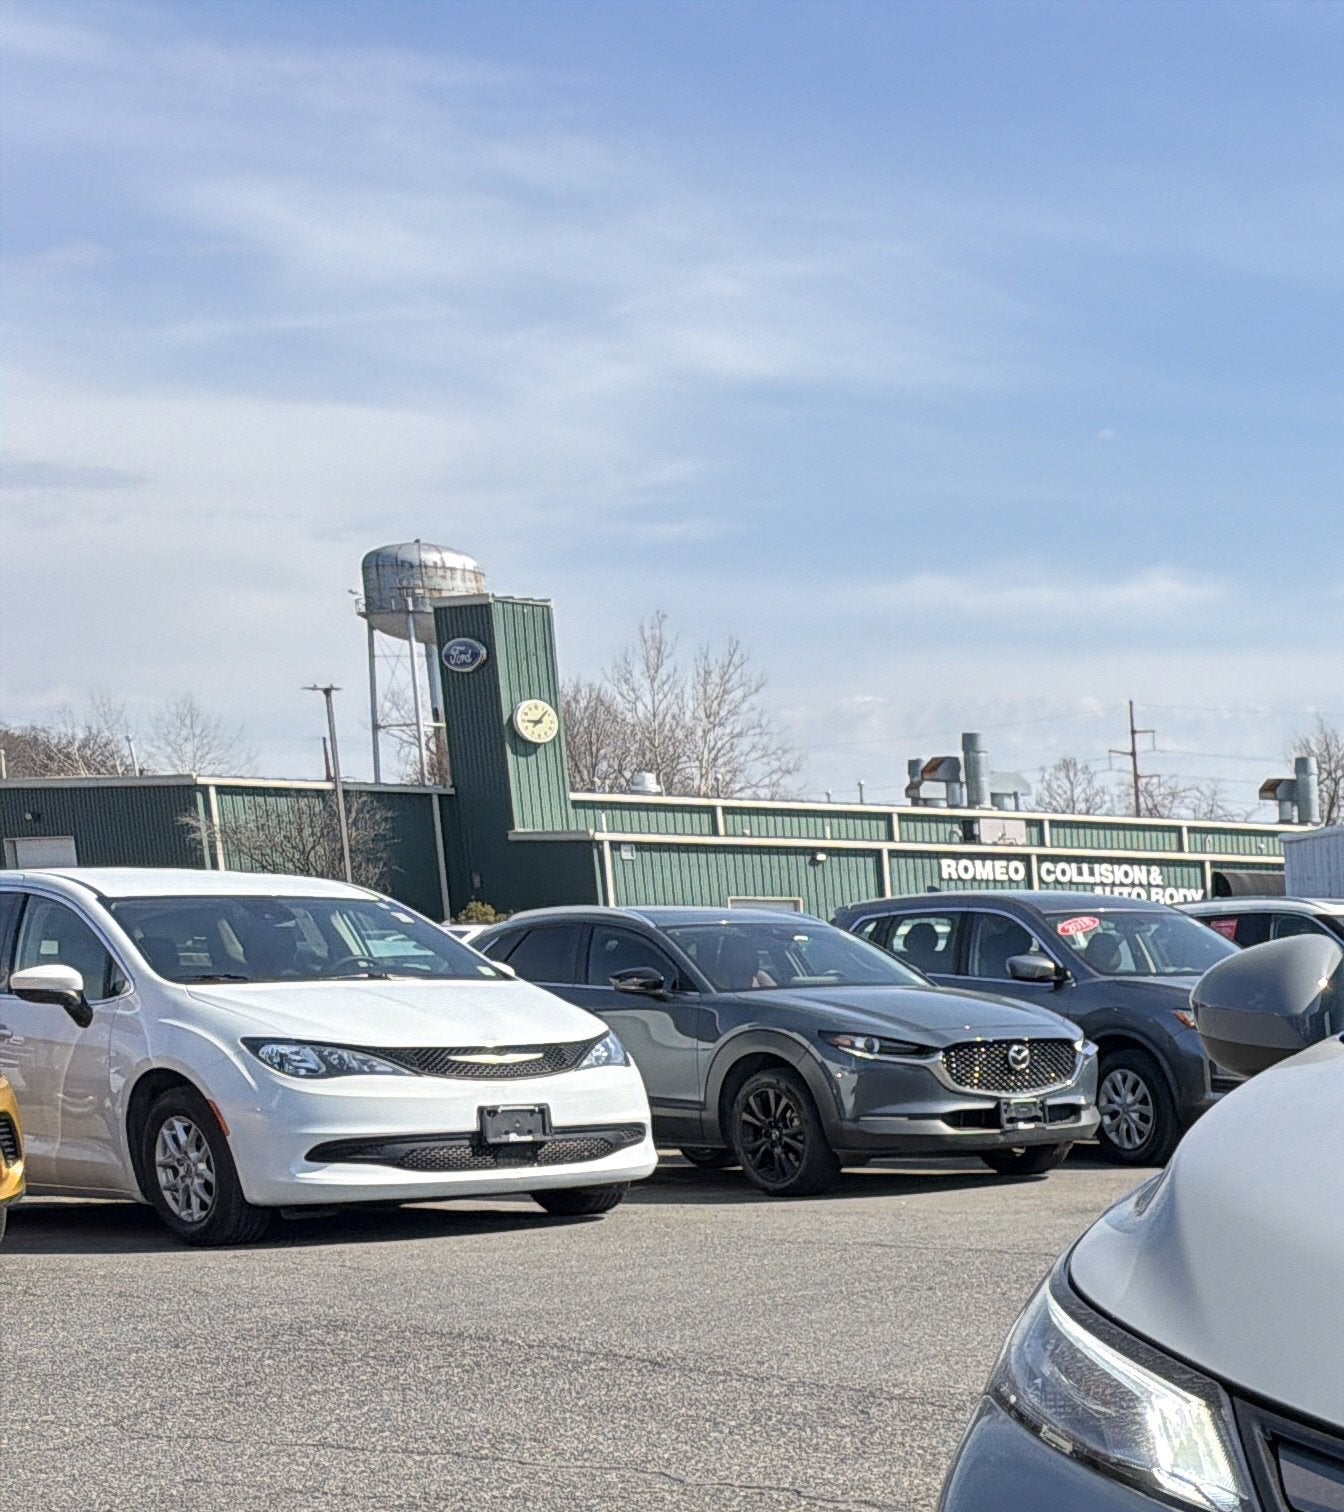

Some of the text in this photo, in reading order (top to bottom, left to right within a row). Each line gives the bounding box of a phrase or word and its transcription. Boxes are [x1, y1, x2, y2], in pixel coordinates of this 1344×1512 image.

[450, 646, 473, 664] Ford
[940, 858, 1163, 886] ROMEO COLLISION &
[1150, 887, 1204, 905] BODY
